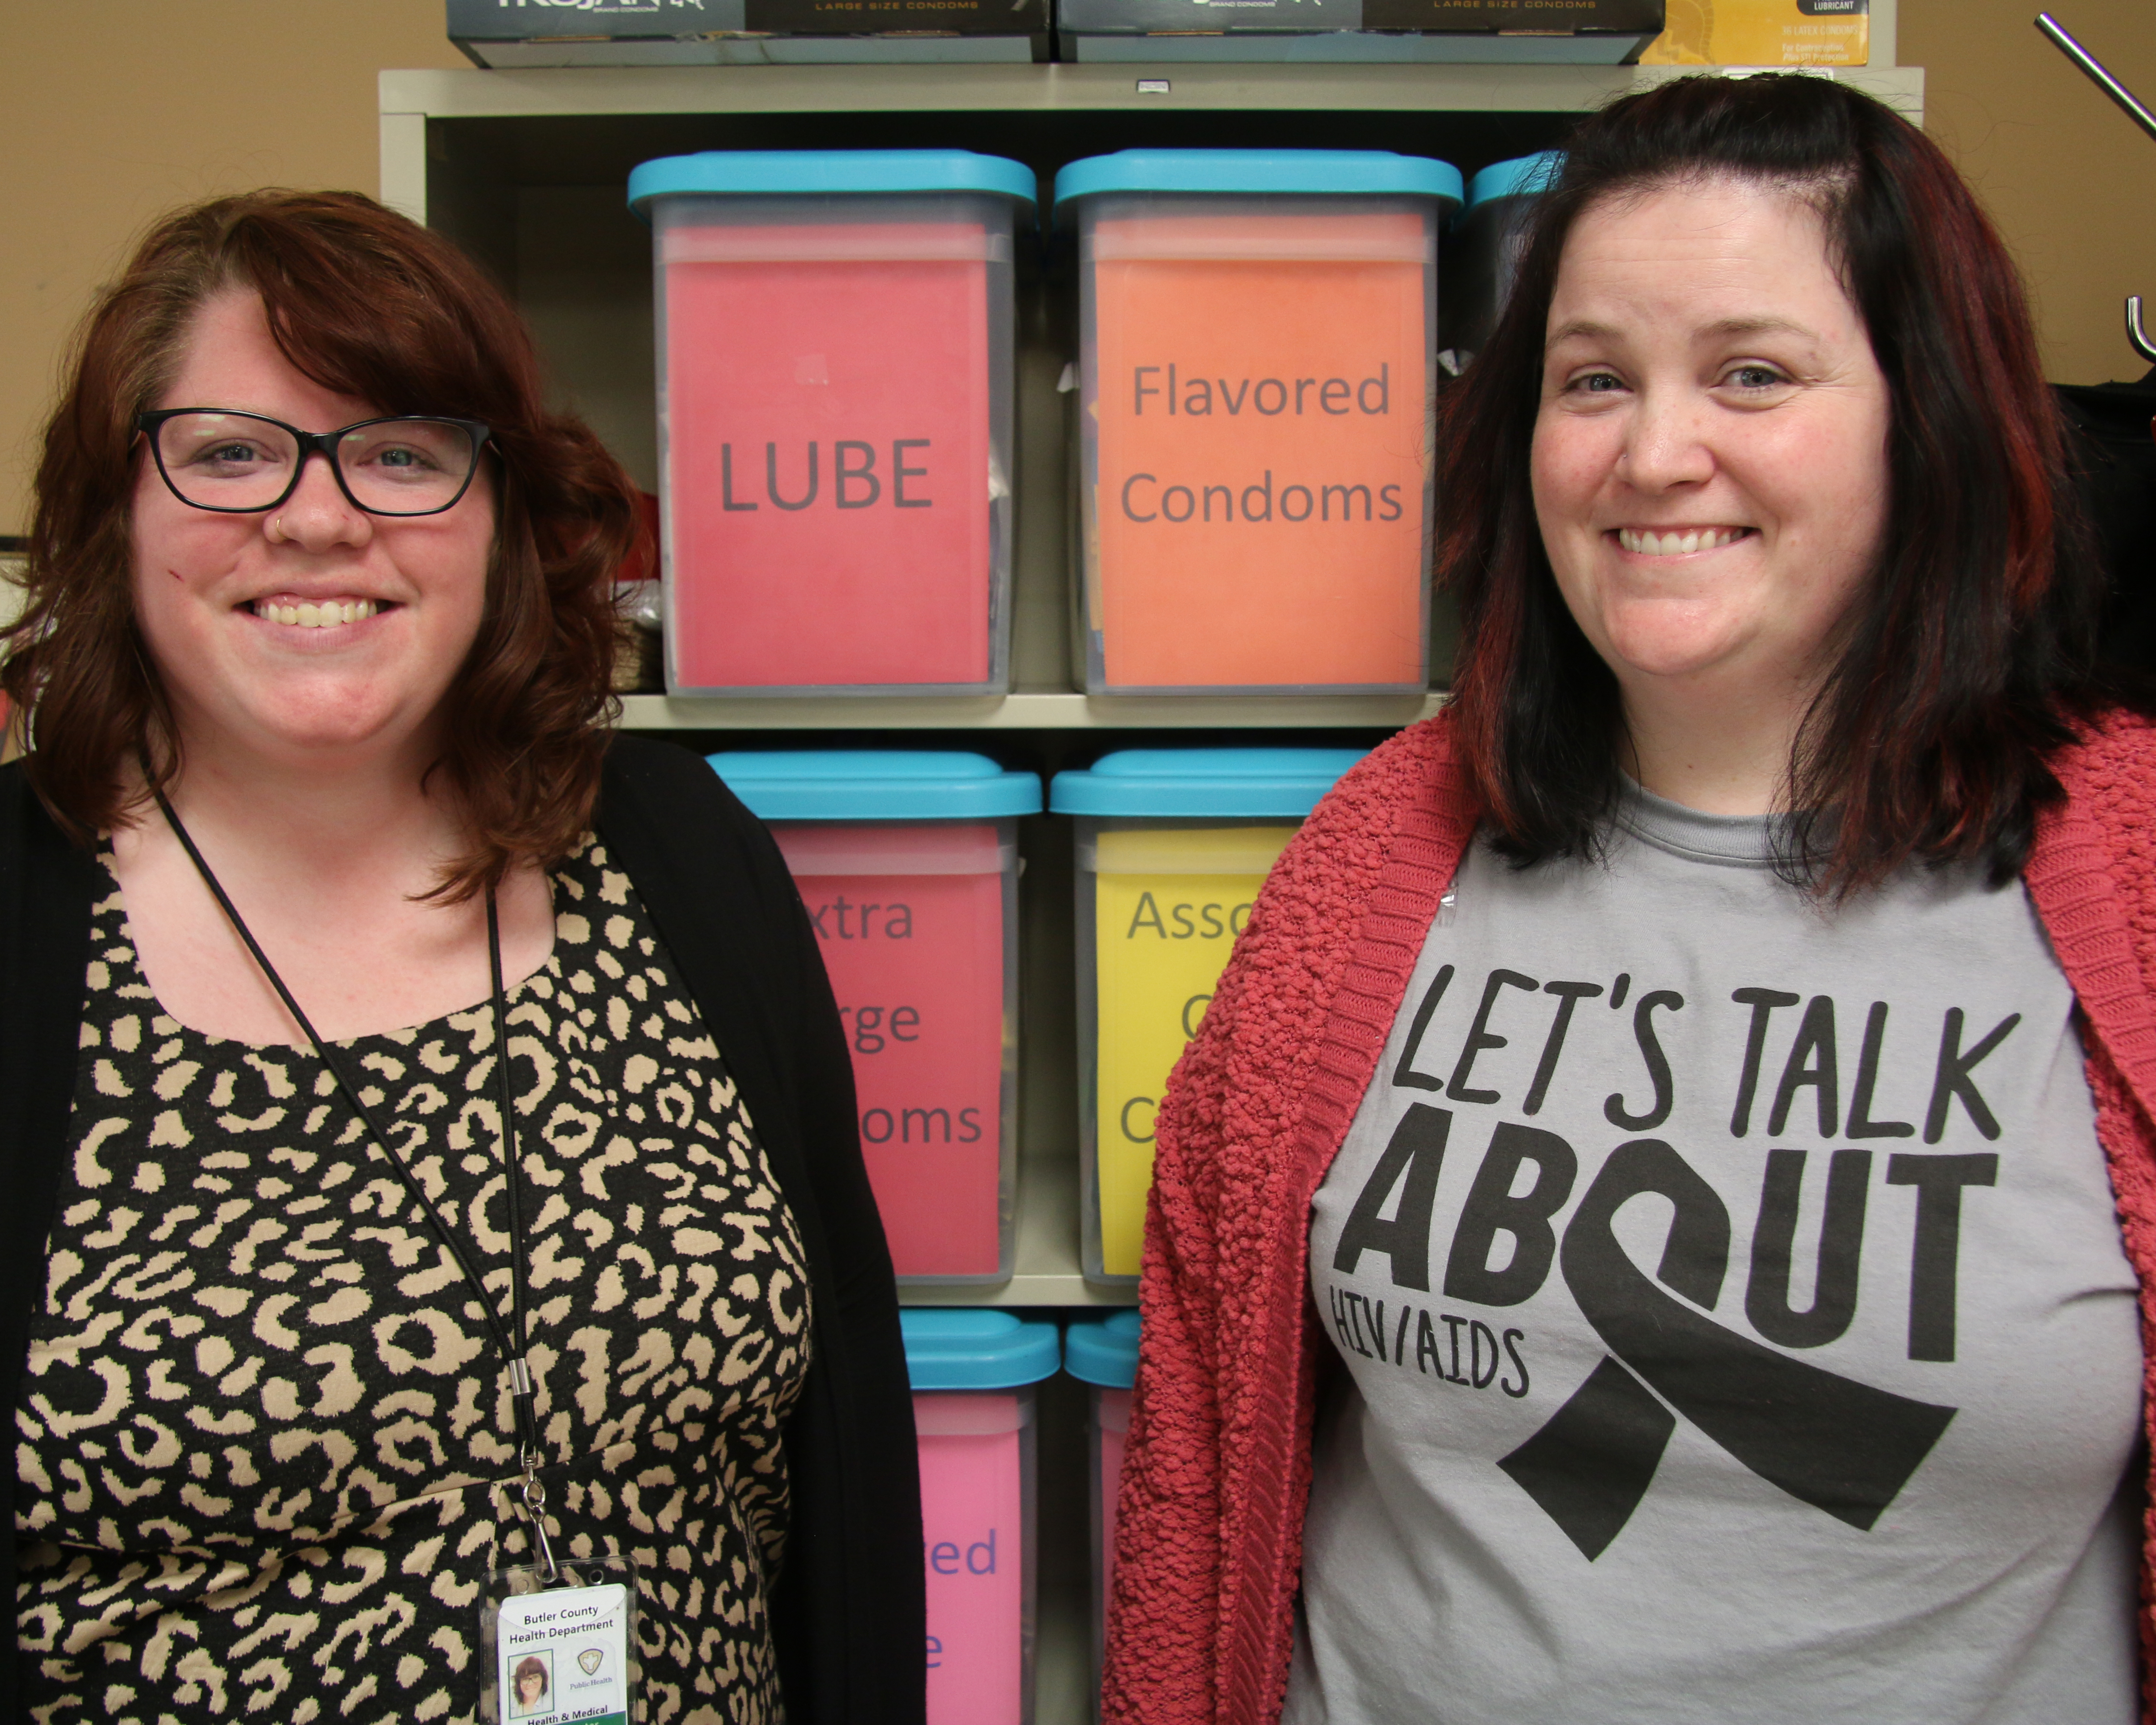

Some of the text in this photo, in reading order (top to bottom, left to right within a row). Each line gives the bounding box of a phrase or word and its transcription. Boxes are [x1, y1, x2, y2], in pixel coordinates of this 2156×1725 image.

[815, 1, 979, 10] LARGE SIZE CONDOMS
[1434, 0, 1596, 9] LARGE SIZE CONDOMS
[1814, 1, 1854, 10] LUBRICANT
[1782, 25, 1860, 35] 36 LATEX CONDOMS
[1782, 43, 1794, 52] For
[1133, 362, 1390, 416] Flavored
[721, 438, 933, 512] LUBE
[1121, 470, 1404, 523] Condoms
[803, 896, 913, 940] xtra
[1392, 964, 2022, 1145] LET'S TALK
[861, 1107, 982, 1144] oms
[1332, 1101, 1999, 1363] ABOUT
[1330, 1284, 1530, 1398] HIV/AIDS
[524, 1606, 599, 1625] Butler County
[509, 1619, 614, 1644] Health Department
[569, 1676, 613, 1690] Public Health
[528, 1704, 608, 1725] Health & Medical
